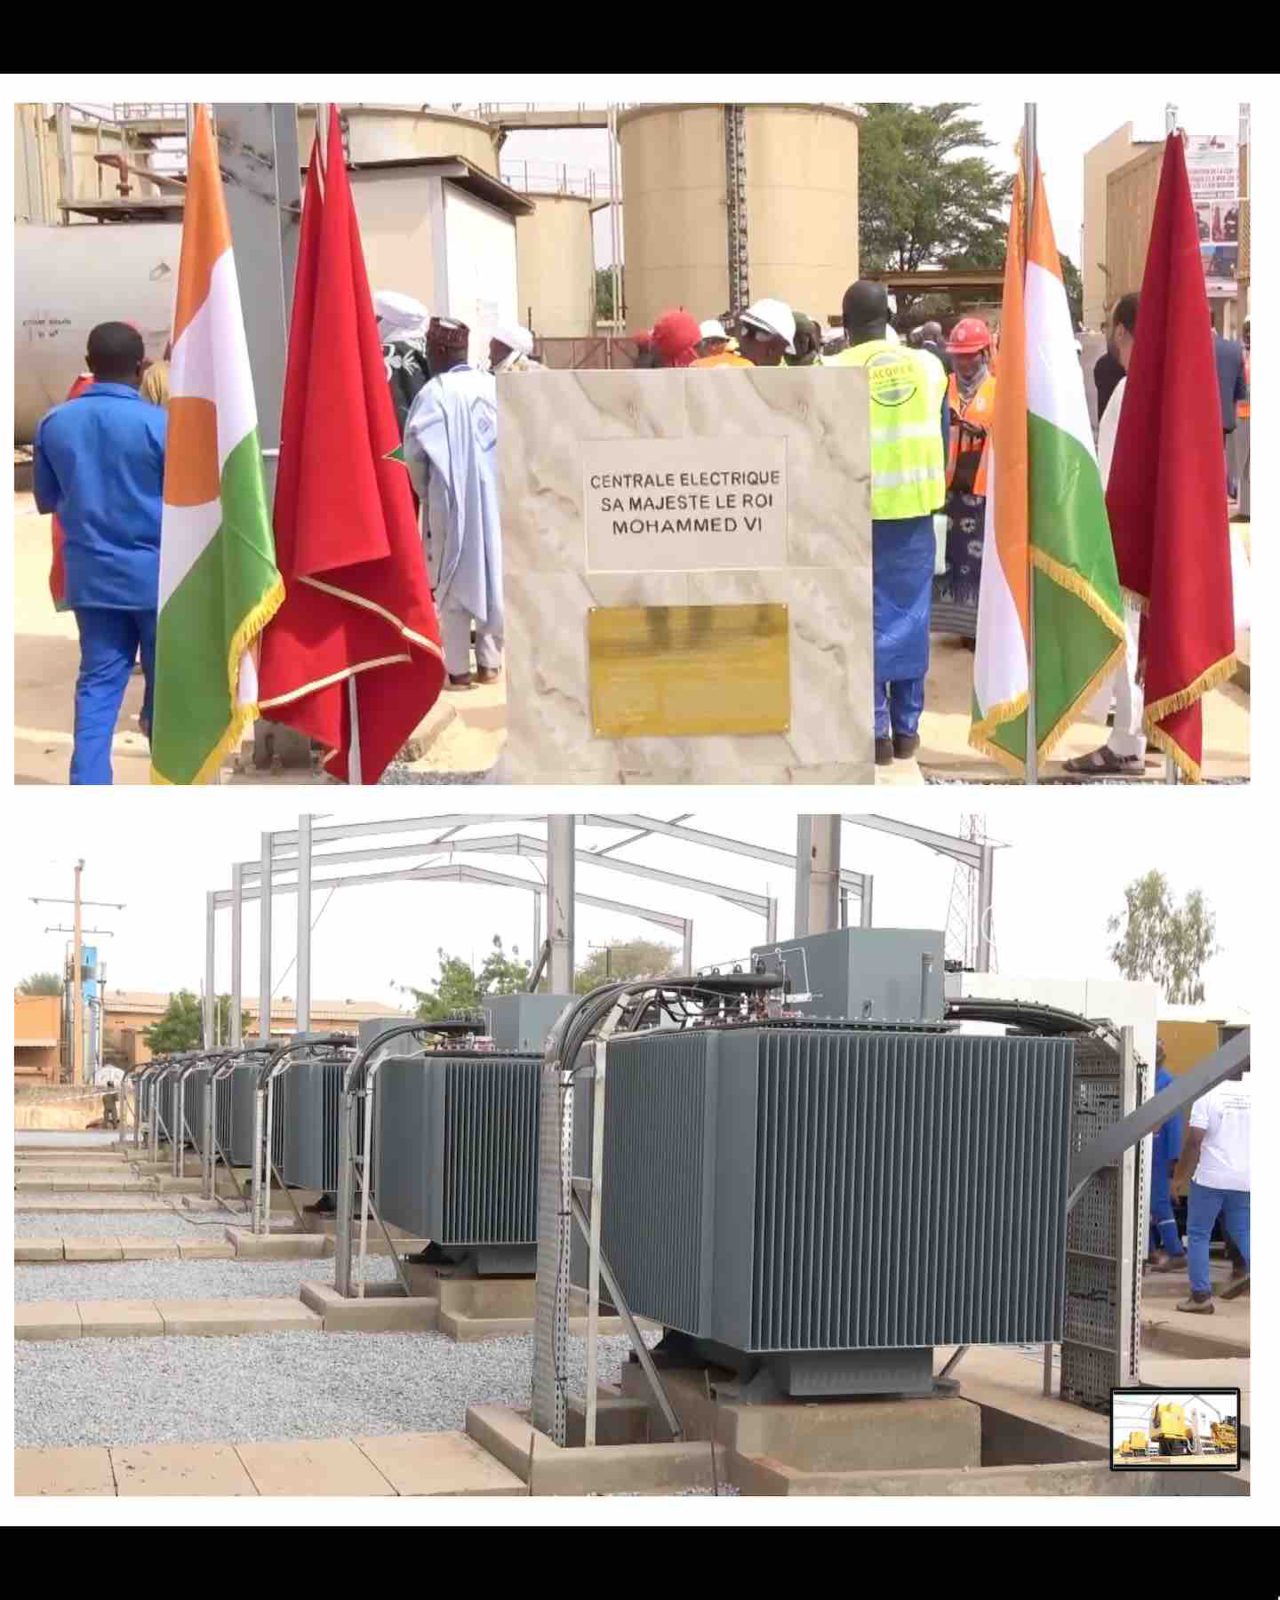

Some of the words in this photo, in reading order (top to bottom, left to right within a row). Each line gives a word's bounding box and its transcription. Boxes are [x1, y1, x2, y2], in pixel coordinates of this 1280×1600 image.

[590, 472, 676, 489] CENTRALE
[680, 470, 781, 486] ELECTRIQUE
[601, 497, 624, 512] SA
[628, 494, 710, 511] MAJESTE
[716, 494, 737, 509] LE
[742, 493, 773, 508] ROI
[612, 517, 738, 535] MOHAMMED
[743, 517, 763, 532] VI
